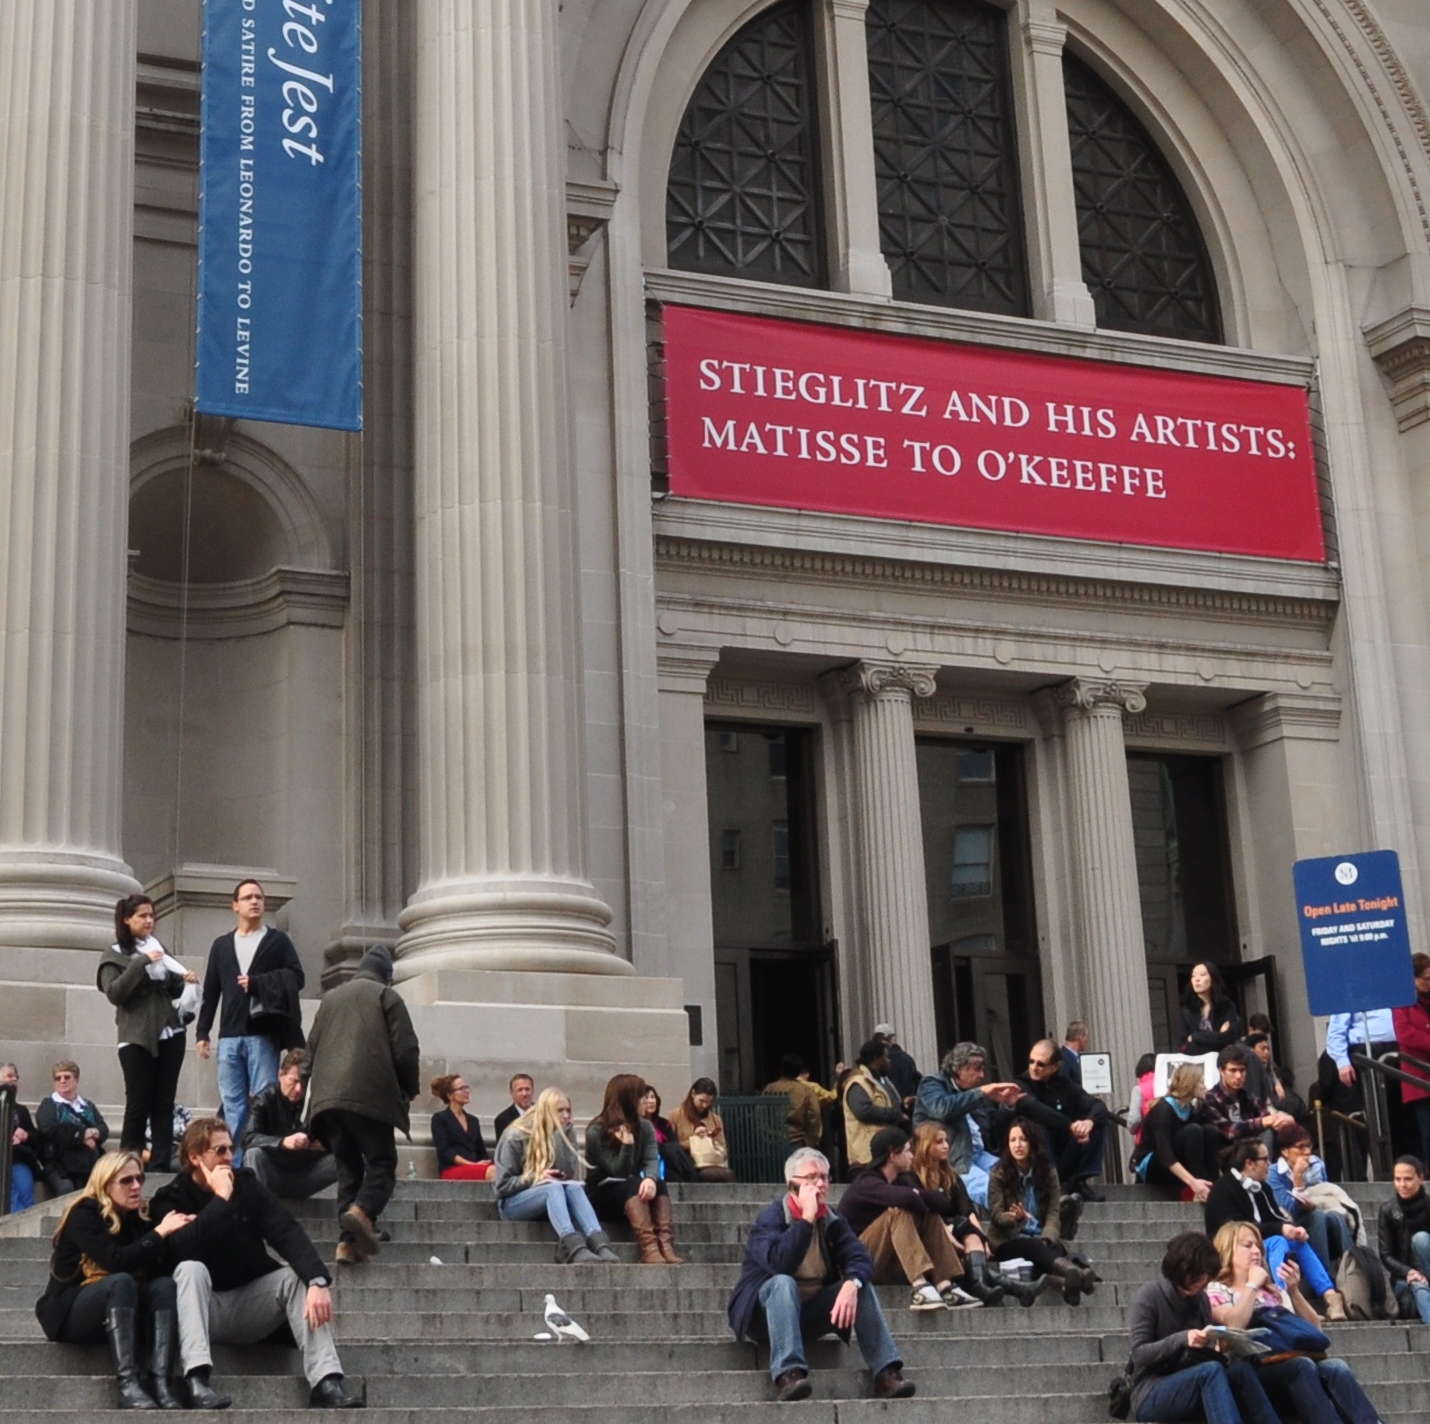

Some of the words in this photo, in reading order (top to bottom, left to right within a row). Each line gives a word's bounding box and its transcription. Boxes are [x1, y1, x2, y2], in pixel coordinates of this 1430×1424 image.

[241, 18, 256, 88] SATIRE
[240, 94, 255, 151] FROM
[267, 47, 334, 166] Jest
[238, 158, 254, 274] LEONARDO
[237, 280, 252, 309] TO
[235, 317, 251, 394] LEVINE
[699, 359, 927, 417] STIEGLITZ
[943, 390, 1030, 427] AND
[1045, 402, 1117, 439] HIS
[1130, 413, 1296, 460] ARTISTS:
[701, 417, 888, 468] MATISSE
[903, 439, 962, 476] TO
[977, 449, 1167, 498] O'KEEFFE
[1303, 905, 1331, 919] Open
[1333, 902, 1356, 914] Late
[1357, 896, 1398, 911] Tonight
